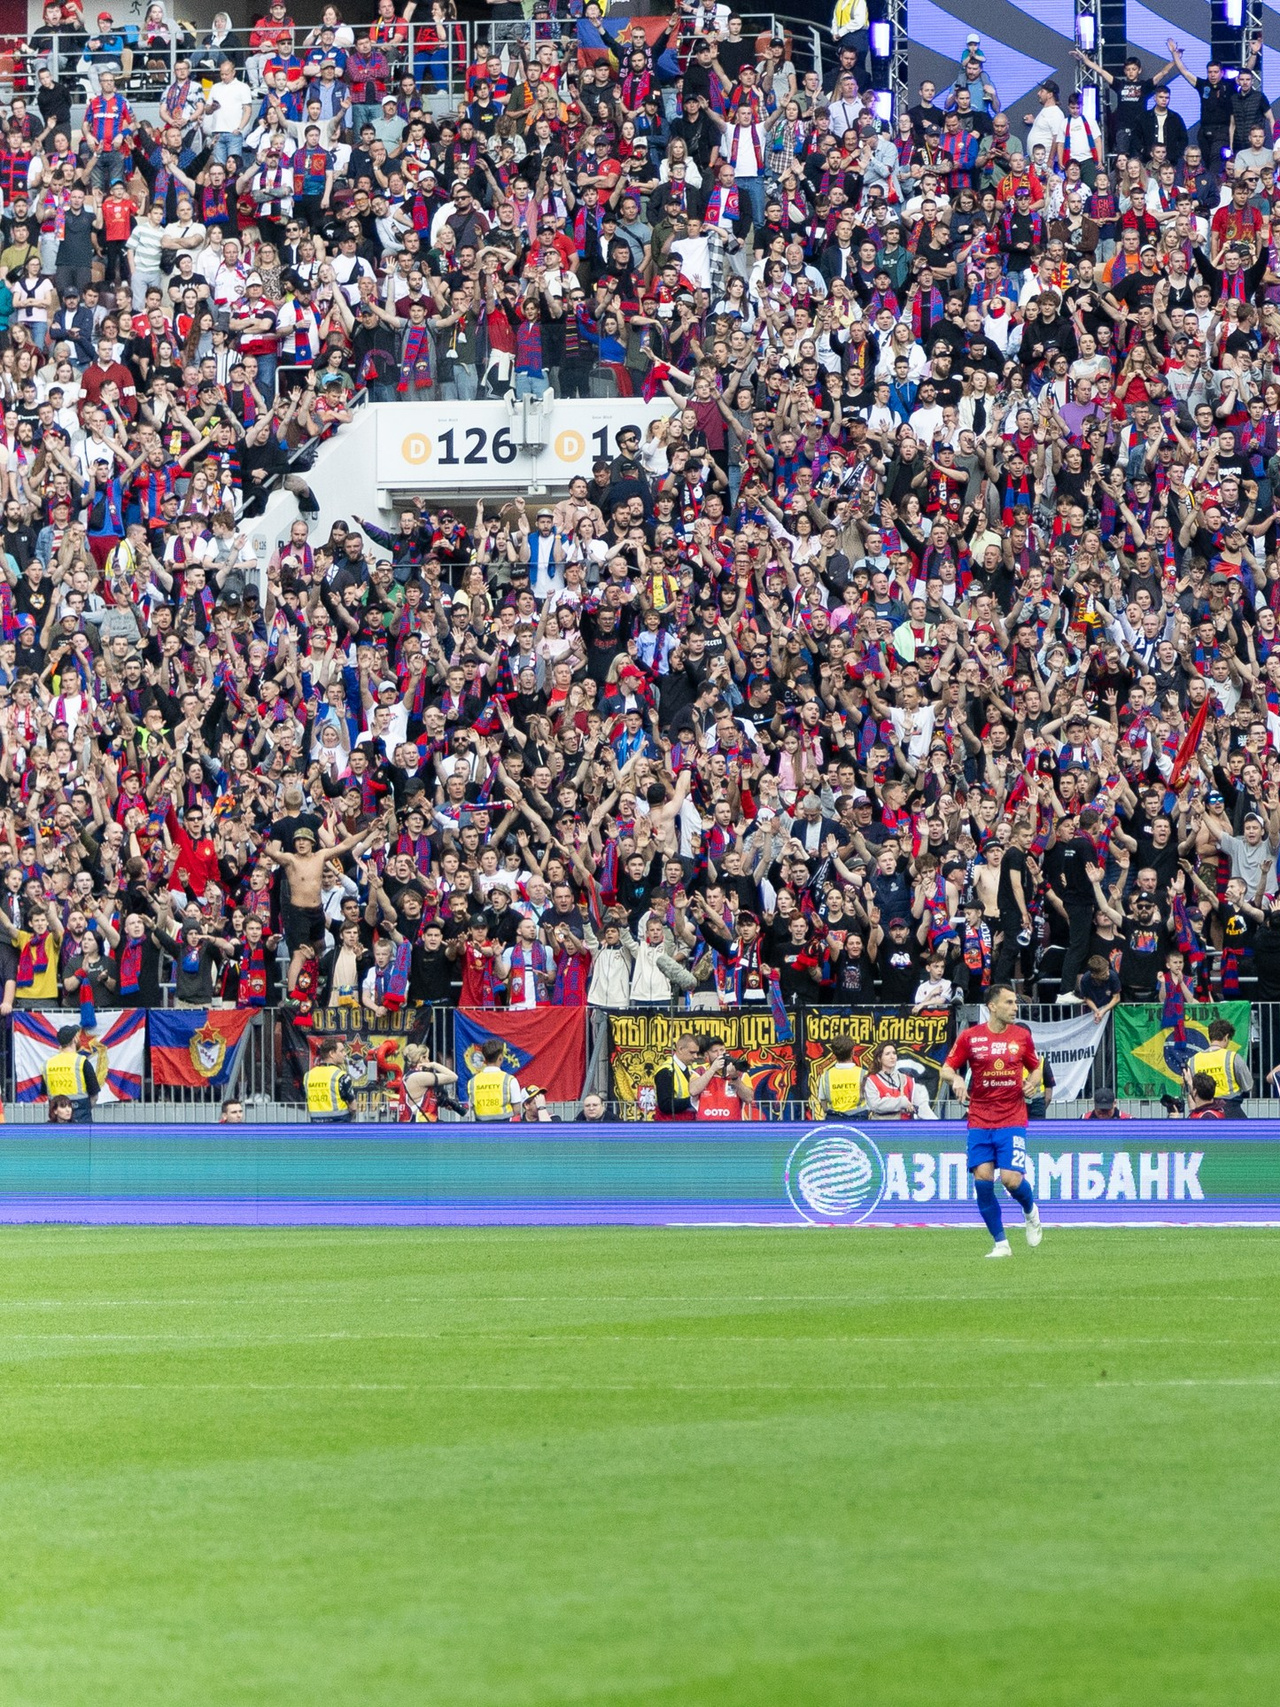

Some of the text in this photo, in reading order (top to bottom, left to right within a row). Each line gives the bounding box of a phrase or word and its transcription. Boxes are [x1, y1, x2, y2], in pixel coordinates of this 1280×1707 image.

[411, 427, 517, 464] D 126
[562, 437, 575, 455] D
[302, 1007, 417, 1031] ОСТОЧНОЕ
[808, 1016, 948, 1042] ВСЕГДА ВМЕСТЕ
[704, 1108, 730, 1117] ФОТО
[1011, 1149, 1026, 1167] 22
